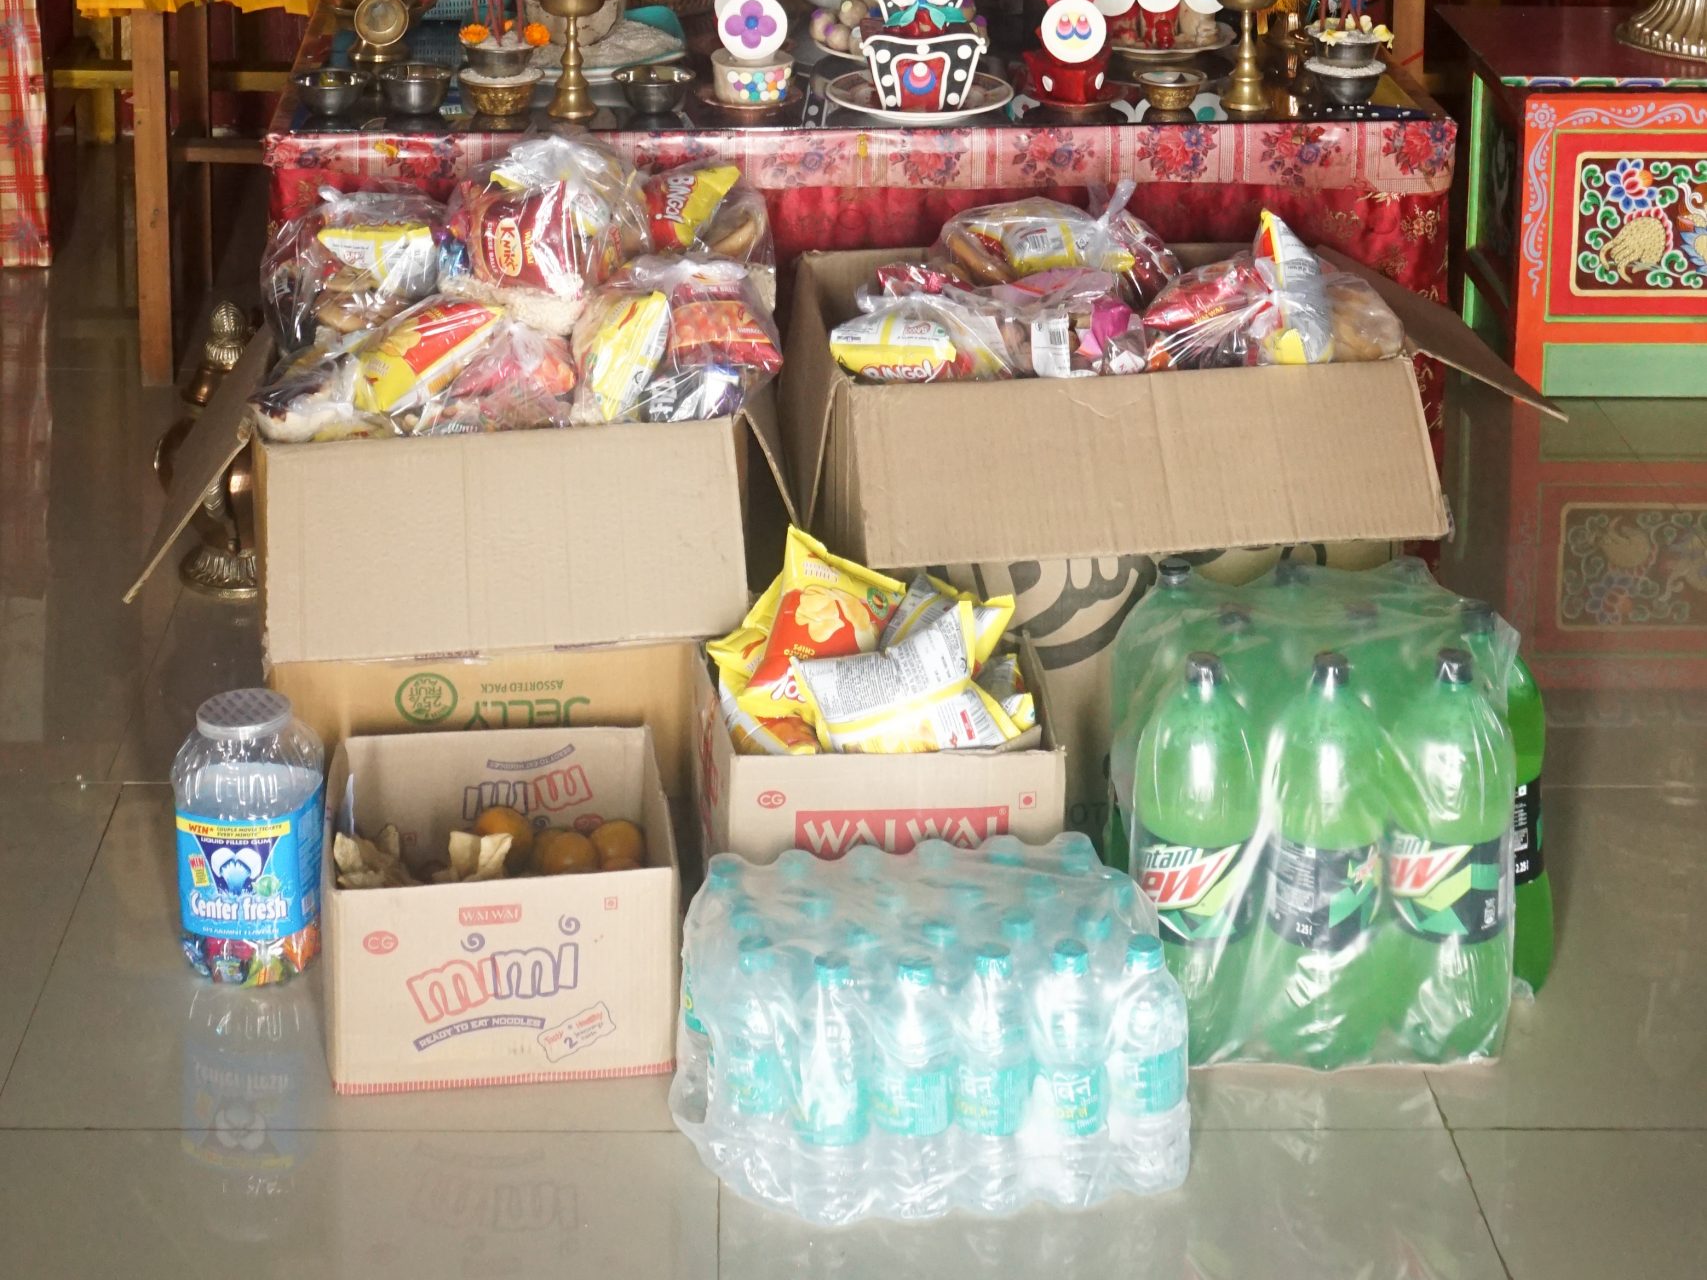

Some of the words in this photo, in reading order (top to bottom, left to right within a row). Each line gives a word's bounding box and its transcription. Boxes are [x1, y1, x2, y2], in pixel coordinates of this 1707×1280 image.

[654, 173, 695, 225] BINGO!
[481, 682, 507, 694] PACK
[509, 679, 564, 693] ASSORTED
[463, 696, 591, 730] JELLY
[759, 793, 784, 805] CG
[200, 837, 225, 845] LIQUID
[190, 891, 238, 920] Center
[243, 894, 288, 920] fresh
[462, 909, 489, 922] WAI
[489, 907, 520, 921] WAI
[366, 934, 395, 950] CG
[406, 913, 580, 1025] mimi
[418, 1024, 454, 1049] READY
[453, 1020, 470, 1035] TO
[471, 1018, 491, 1031] EAT
[491, 1016, 542, 1029] NOODLES
[564, 1036, 579, 1050] 2
